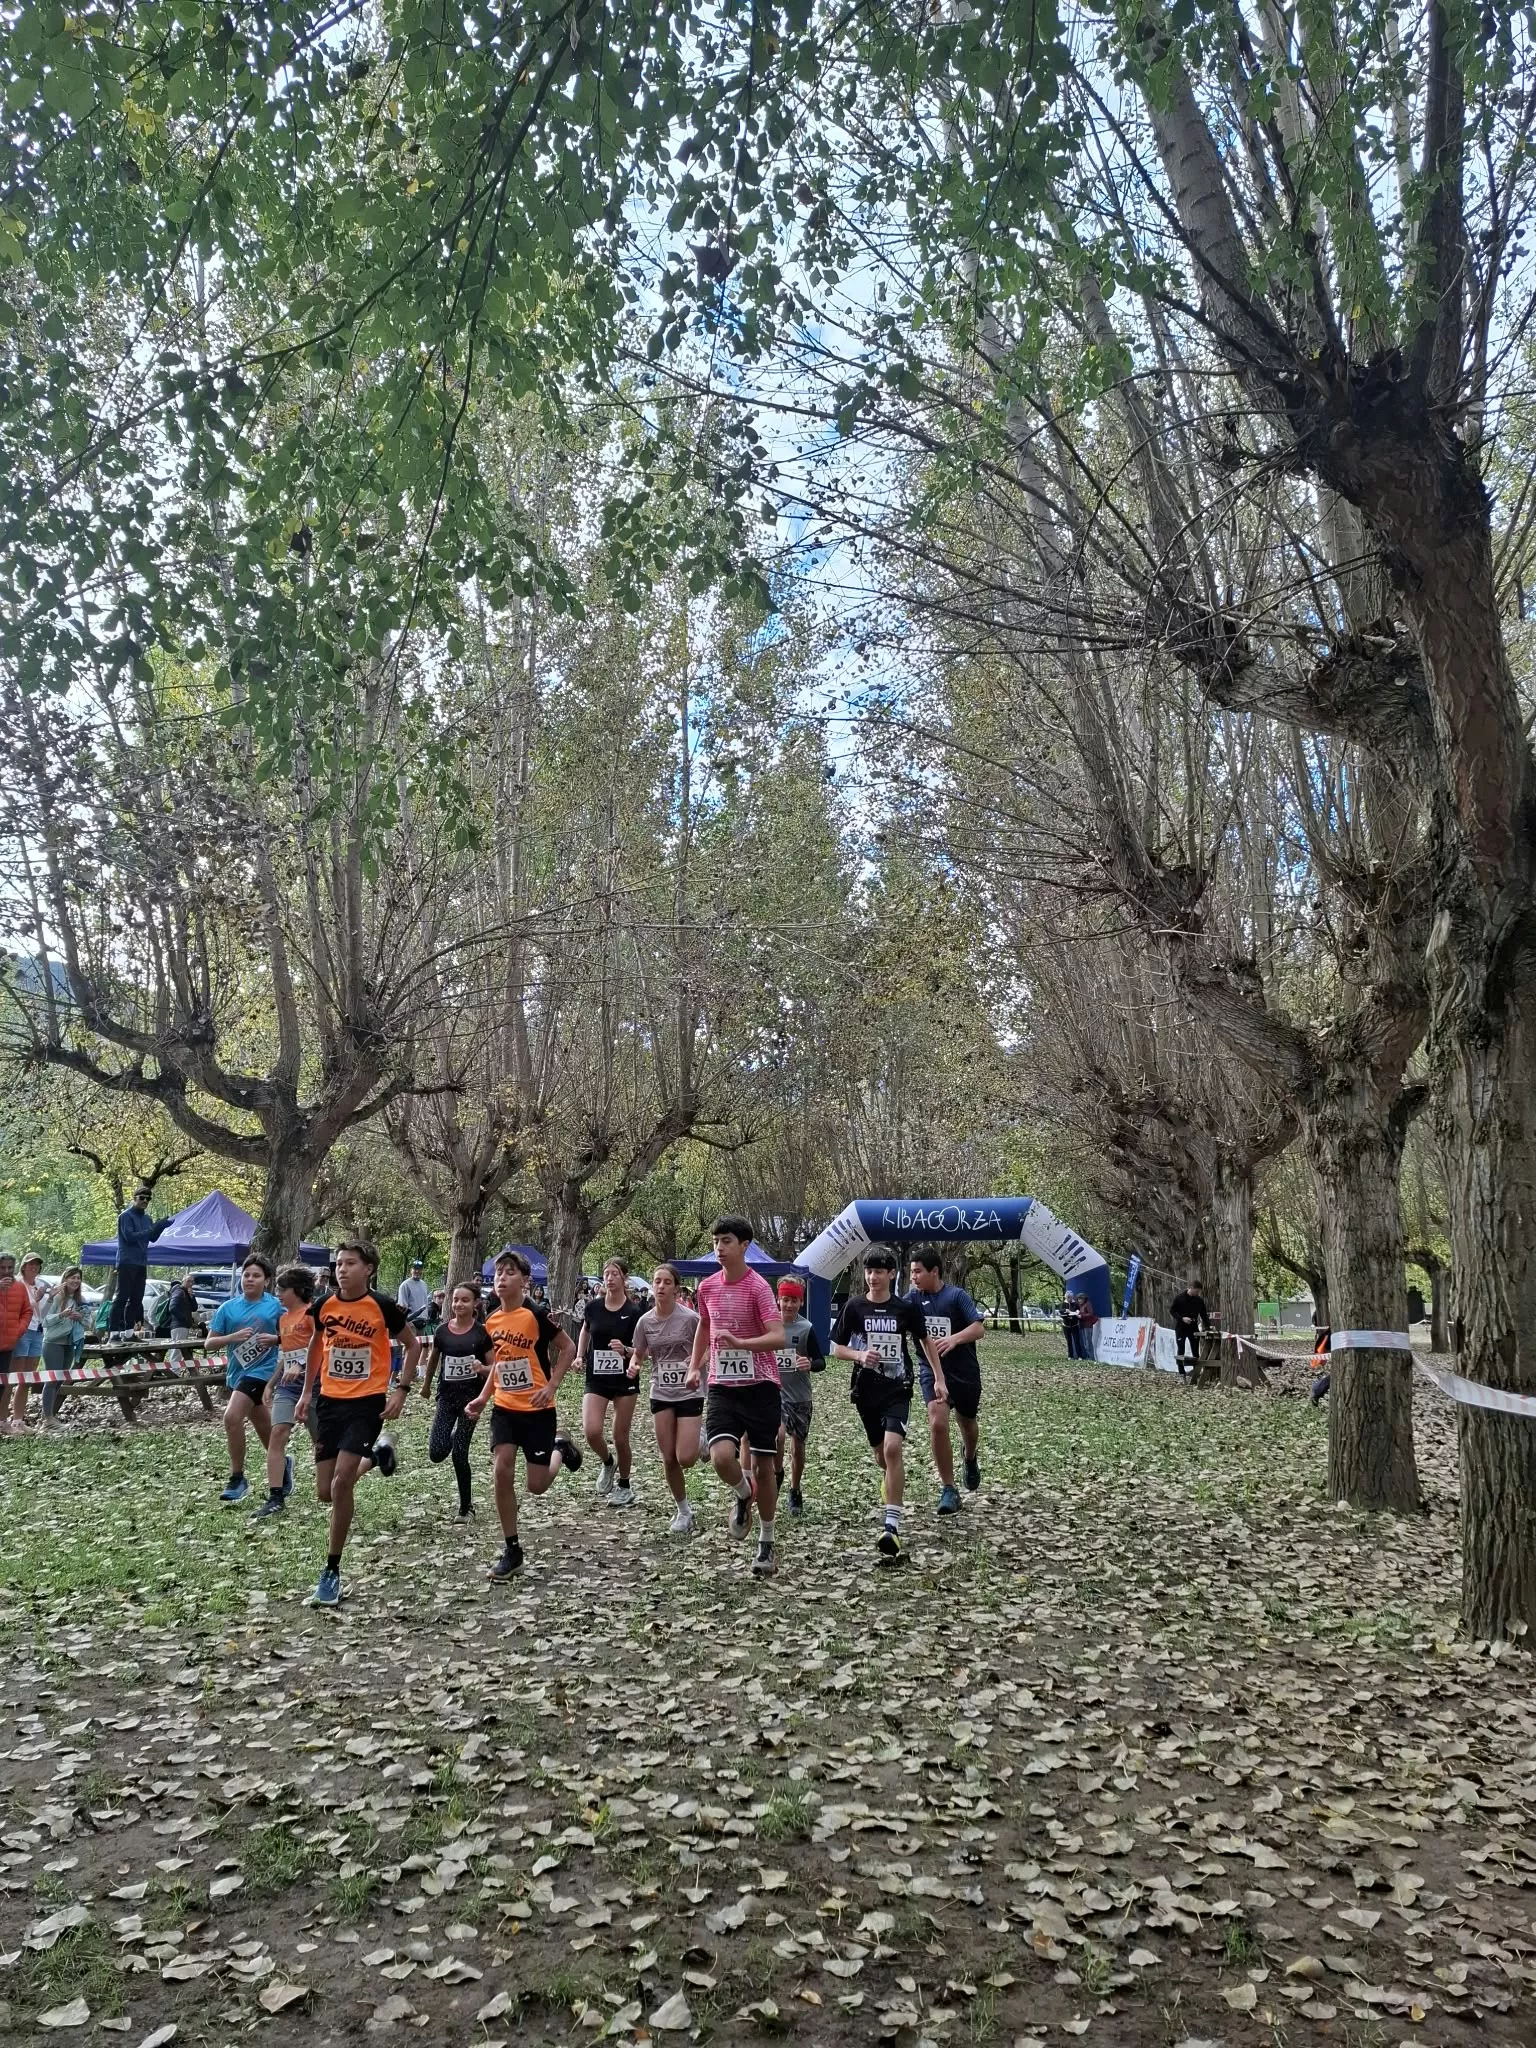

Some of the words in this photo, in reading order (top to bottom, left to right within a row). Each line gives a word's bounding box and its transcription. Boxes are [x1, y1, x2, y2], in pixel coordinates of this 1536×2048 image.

[882, 1205, 1002, 1233] RIBAGORZA
[864, 1318, 897, 1332] GMMB
[873, 1343, 897, 1357] 715
[333, 1359, 365, 1374] 693
[448, 1363, 472, 1376] 735
[597, 1359, 619, 1370] 722
[720, 1360, 748, 1374] 716
[777, 1357, 791, 1368] 29
[502, 1370, 528, 1386] 694
[662, 1371, 686, 1384] 697
